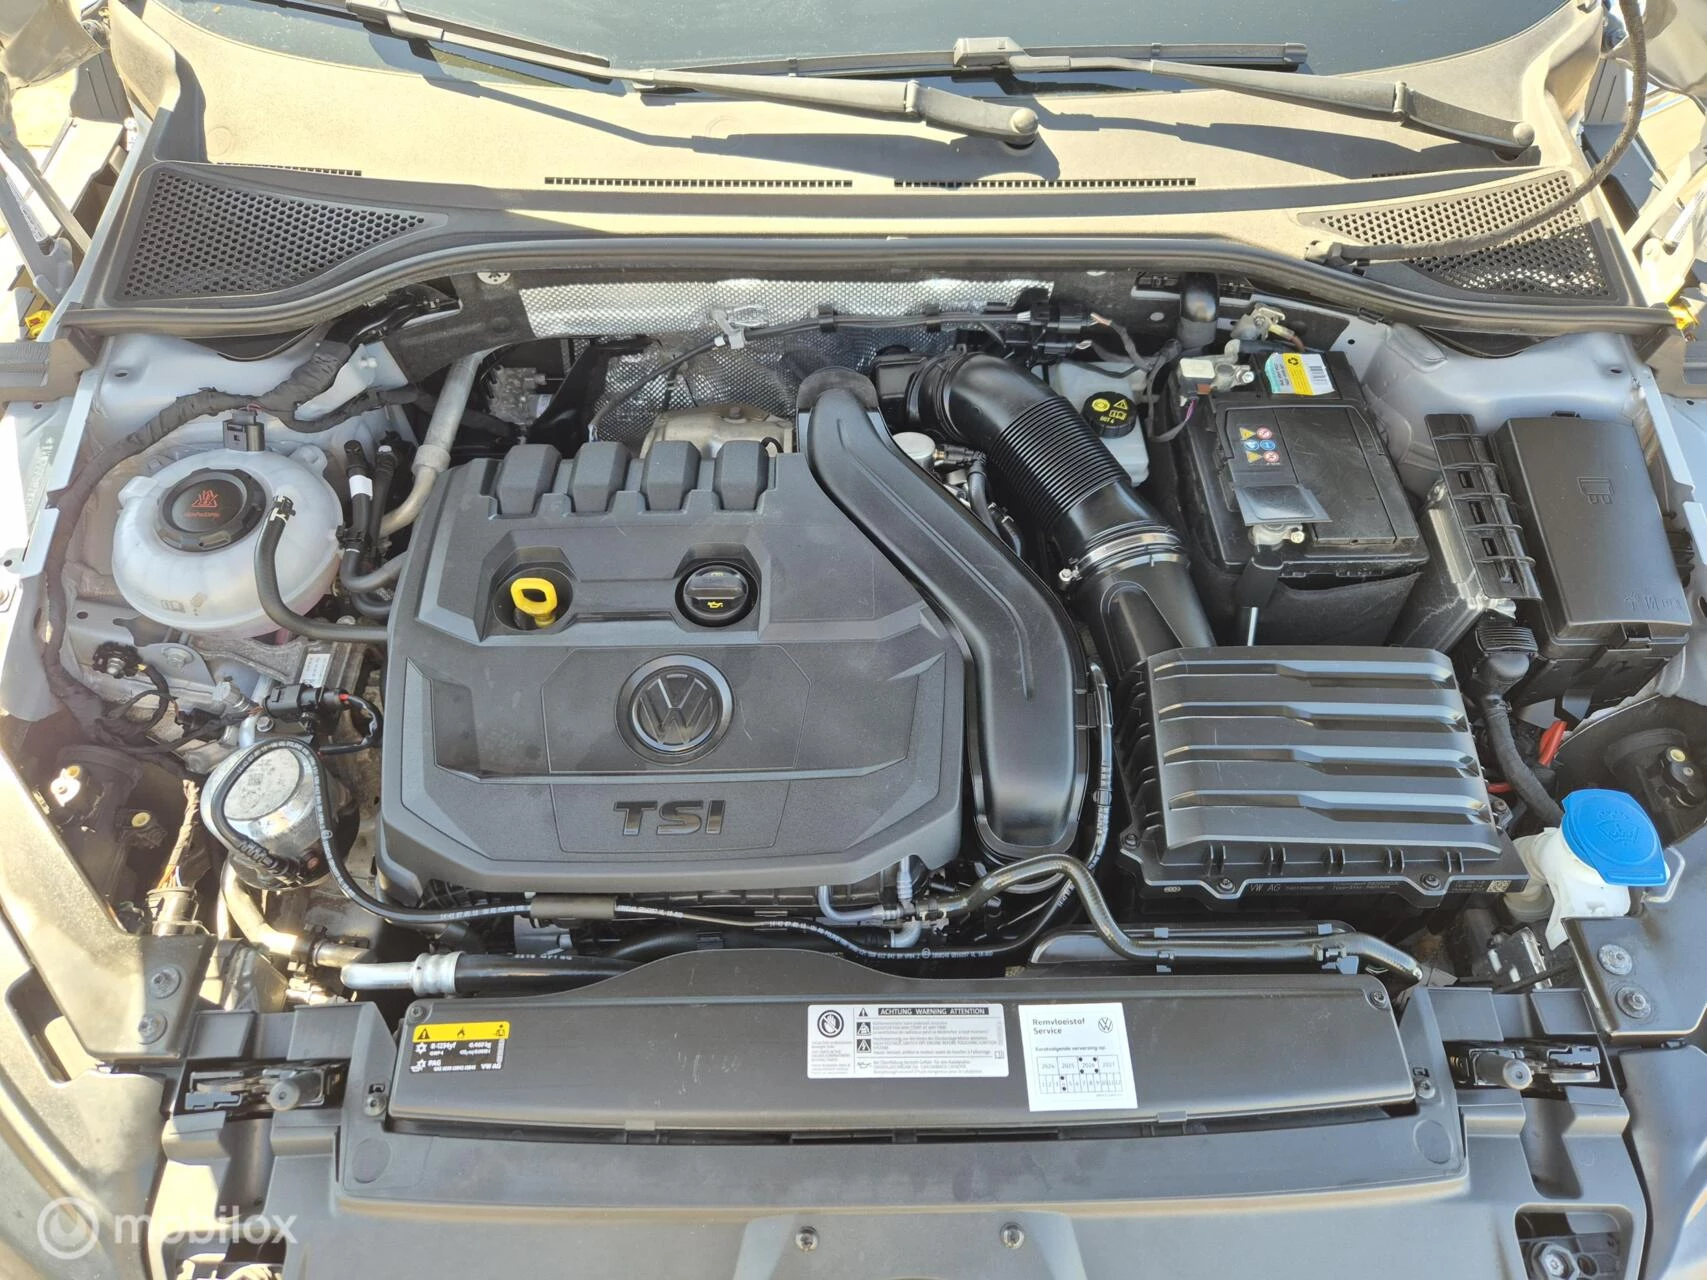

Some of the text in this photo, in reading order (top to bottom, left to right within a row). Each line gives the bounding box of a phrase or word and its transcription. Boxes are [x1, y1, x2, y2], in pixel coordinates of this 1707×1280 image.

[613, 799, 726, 836] TSI
[1250, 884, 1264, 892] VW
[1266, 884, 1281, 892] AG
[880, 1007, 985, 1016] ACHTUNG WARNING ATTENTION
[1032, 1017, 1085, 1026] Remvloeistof
[1033, 1027, 1062, 1035] Service
